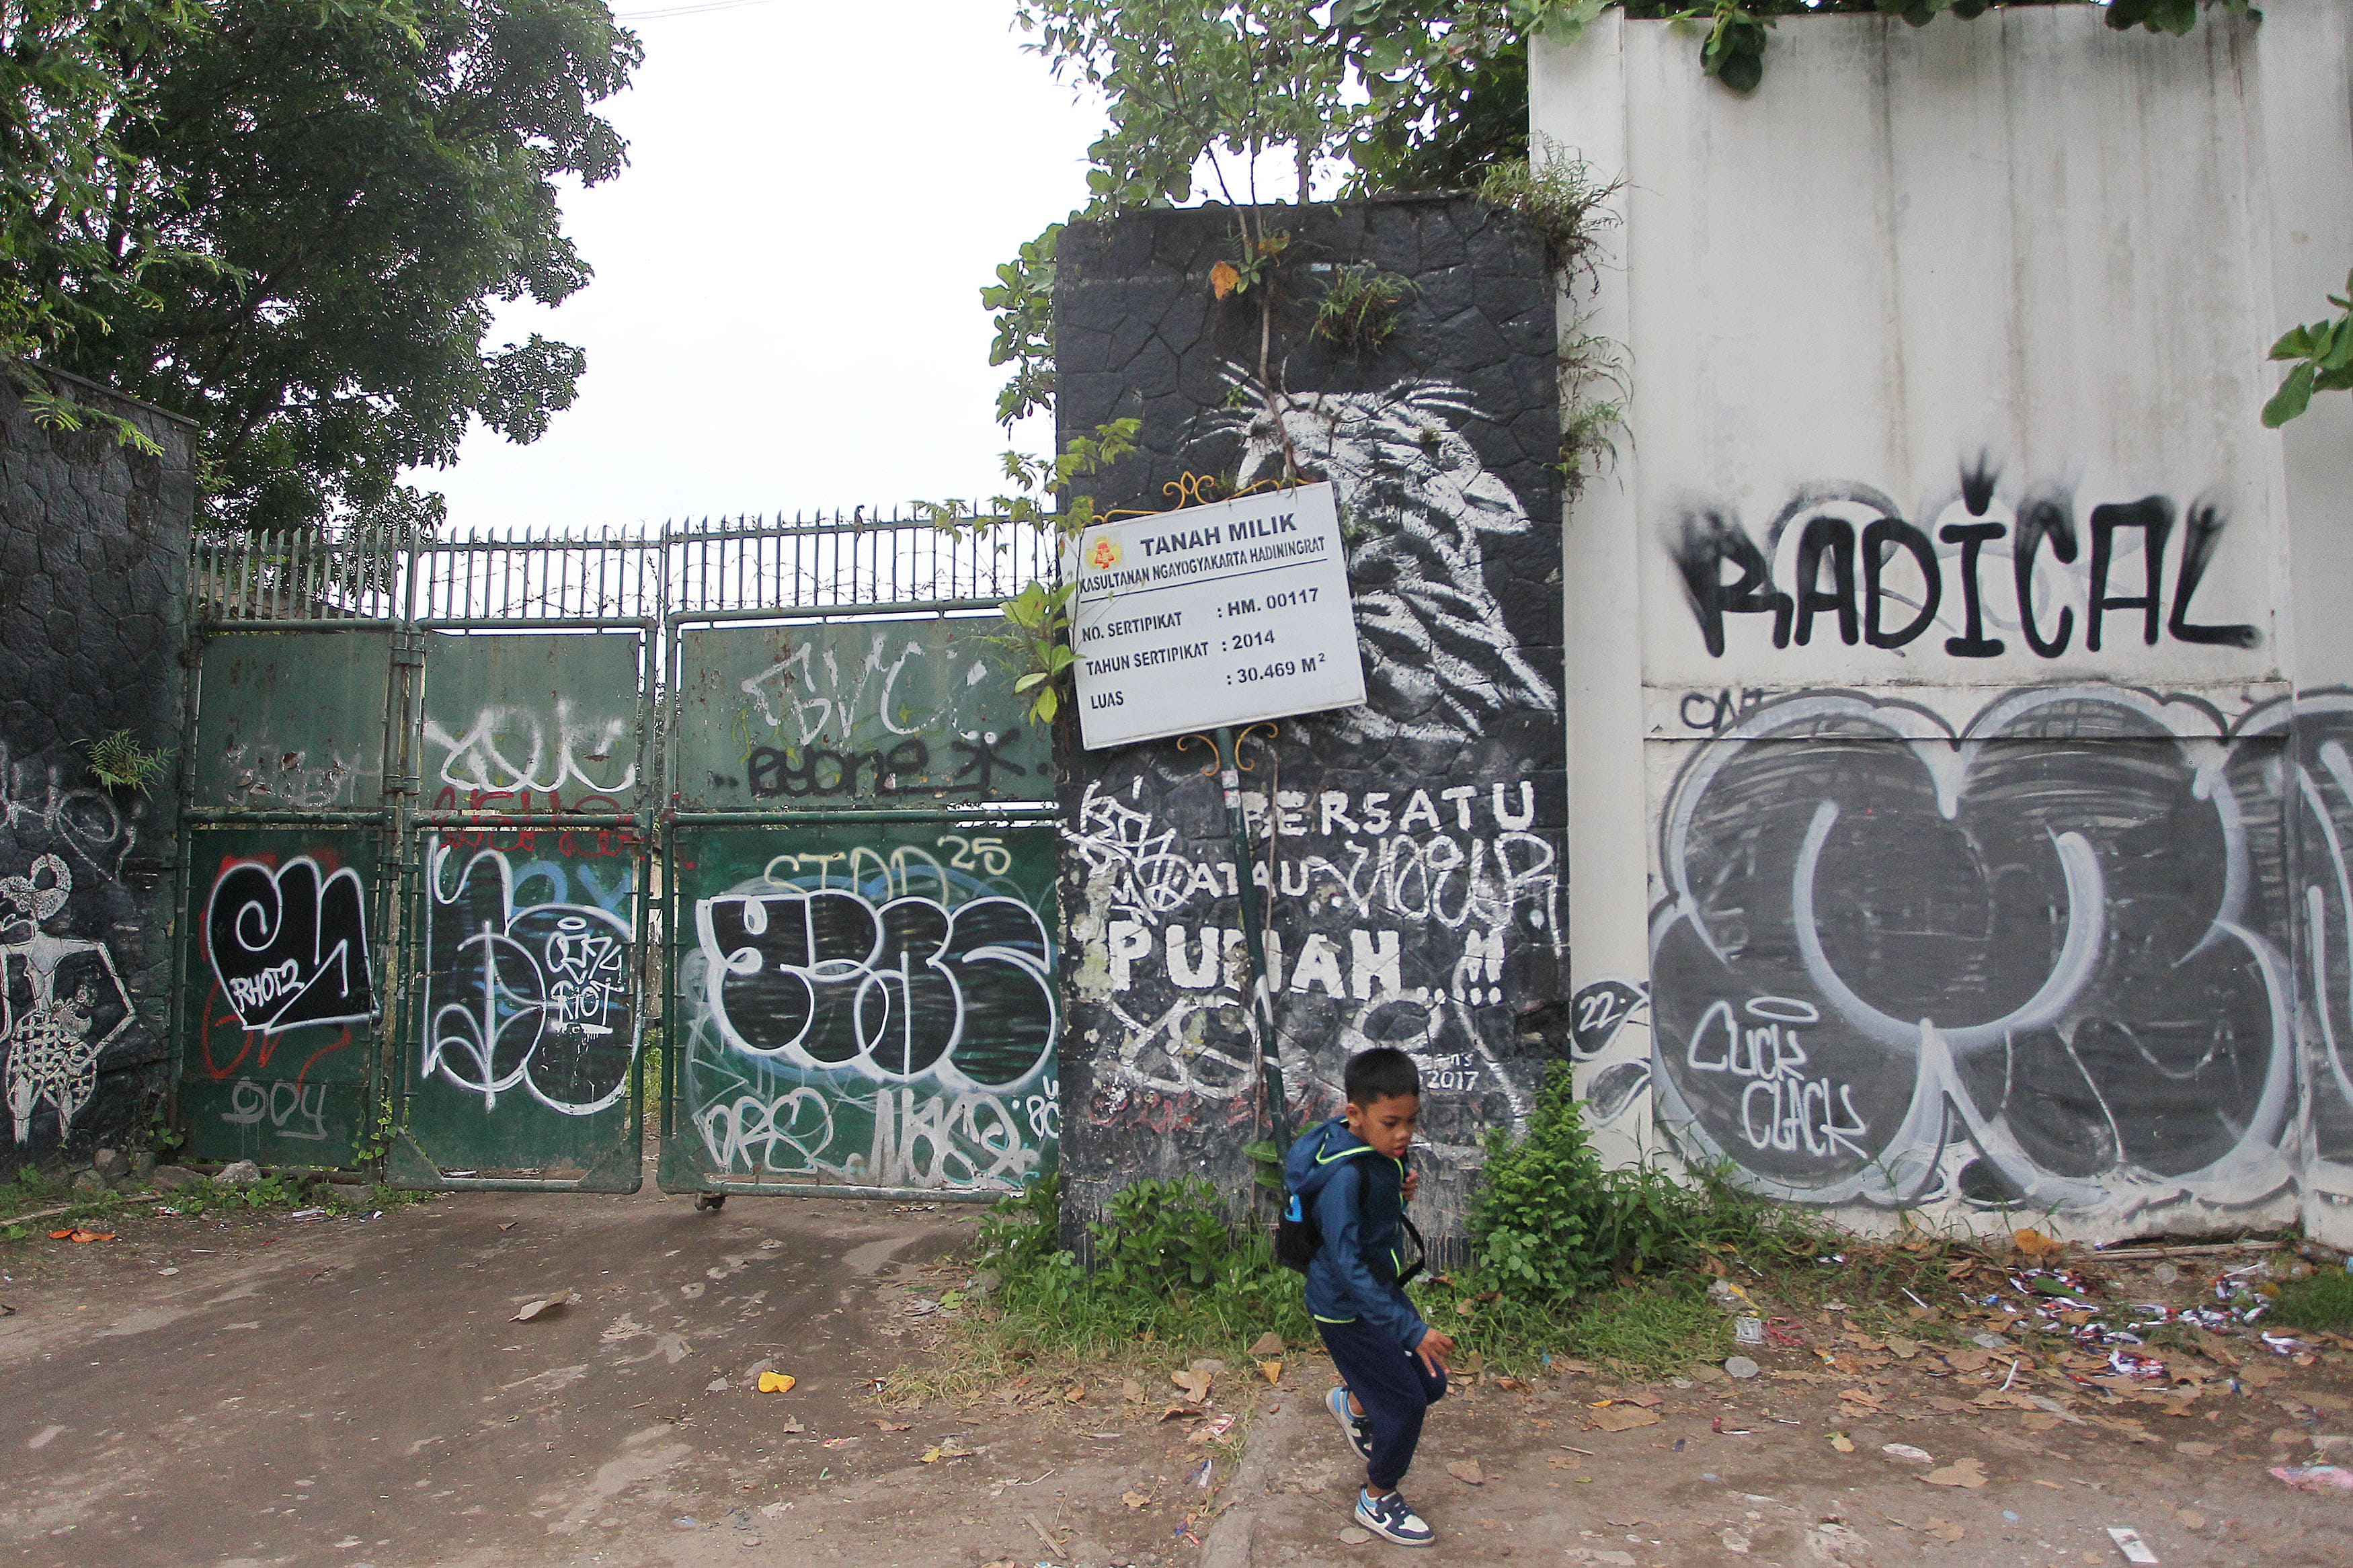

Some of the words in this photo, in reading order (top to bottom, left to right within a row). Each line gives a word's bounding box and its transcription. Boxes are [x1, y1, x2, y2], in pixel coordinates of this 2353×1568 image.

[1140, 526, 1222, 557] TANAH
[1230, 511, 1298, 542] MILIK
[1079, 567, 1150, 594] KASULTANAN
[1153, 550, 1248, 580] NGAYOGYAKARTA
[1250, 536, 1325, 563] HADININGRAT
[1082, 623, 1105, 643] NO.
[1108, 611, 1183, 638] SERTIPIKAT
[1228, 597, 1261, 617] HM.
[1267, 587, 1320, 610] 00117
[1086, 655, 1131, 675] TAHUN
[1133, 641, 1209, 667] SERTIPIKAT
[1232, 629, 1276, 650] 2014
[1090, 690, 1125, 710] LUAS
[1237, 661, 1296, 684] 30.469
[1242, 780, 1535, 839] BERSATU
[1426, 1069, 1480, 1091] 2017
